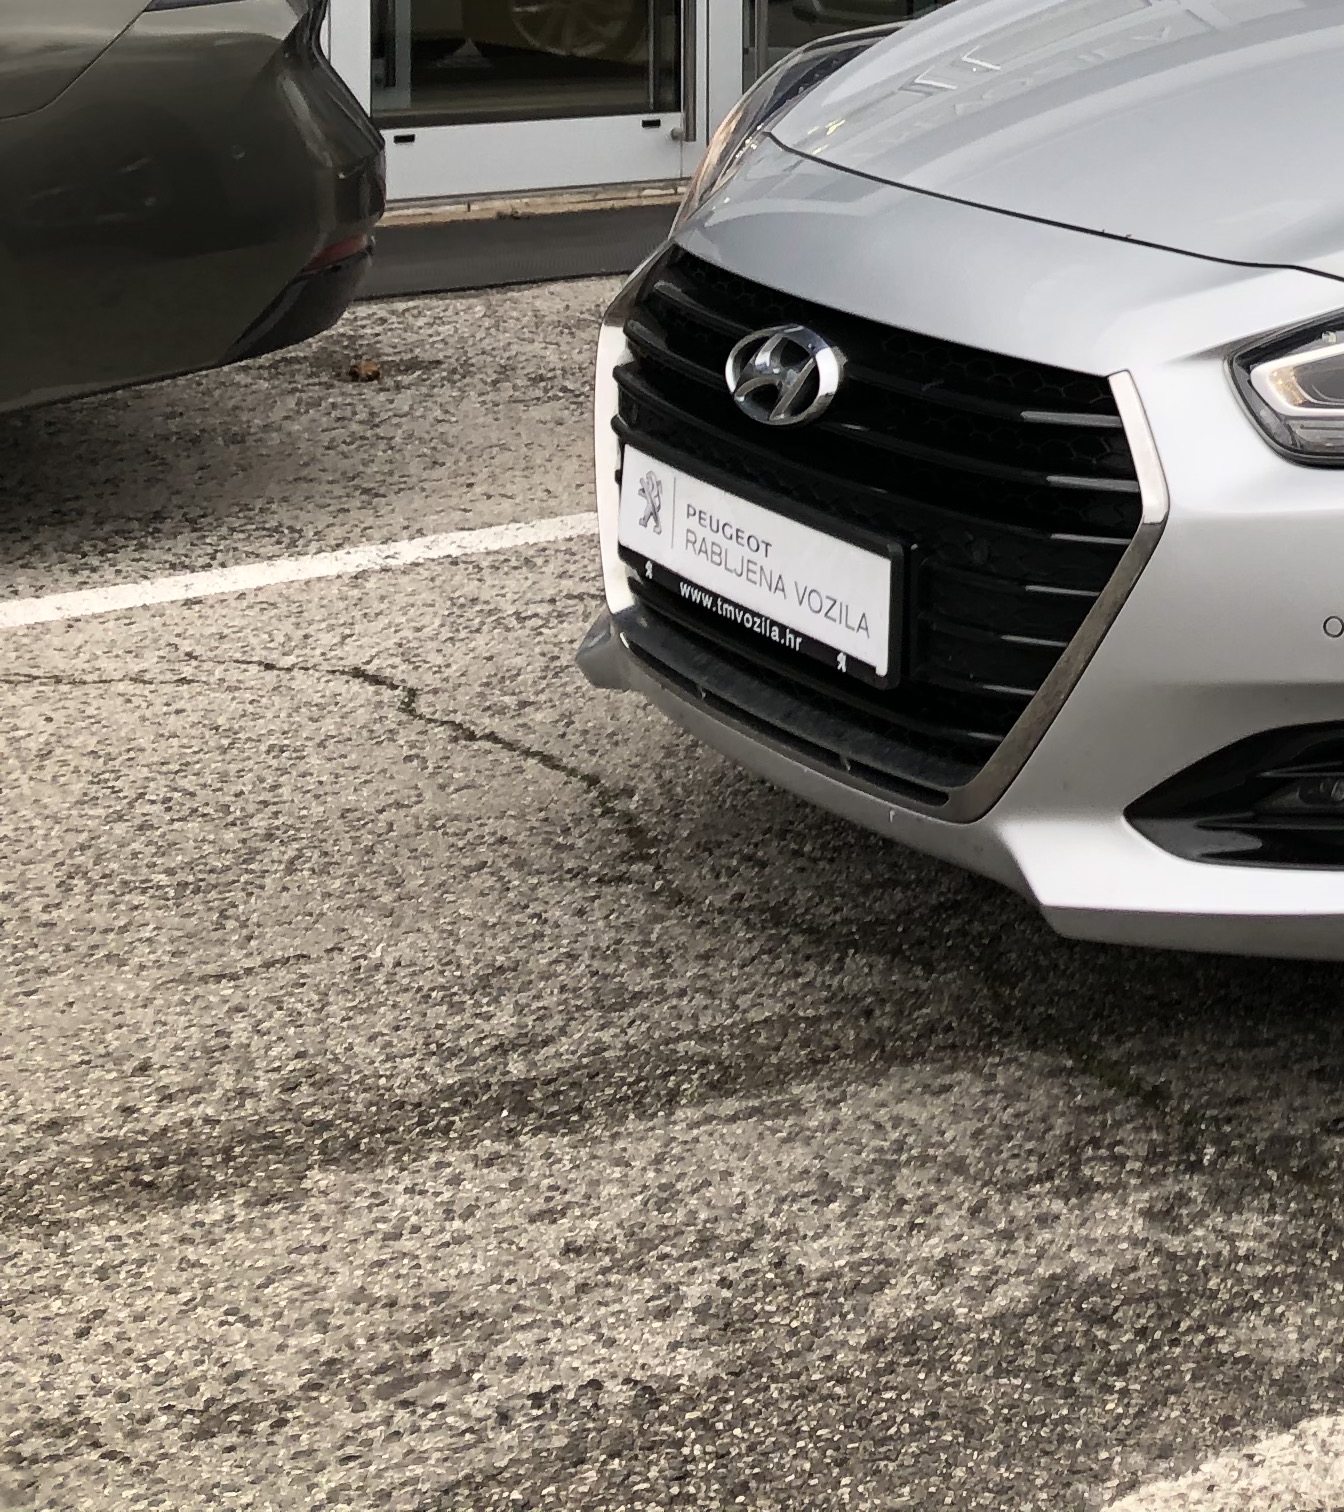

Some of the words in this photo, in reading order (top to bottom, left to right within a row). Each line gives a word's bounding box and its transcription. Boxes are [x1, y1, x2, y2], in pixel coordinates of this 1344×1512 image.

[686, 503, 772, 558] PEUGEOT
[679, 581, 802, 652] www.tmvozila.hr
[685, 528, 788, 600] RABLJENA
[794, 580, 871, 640] VOZILA
